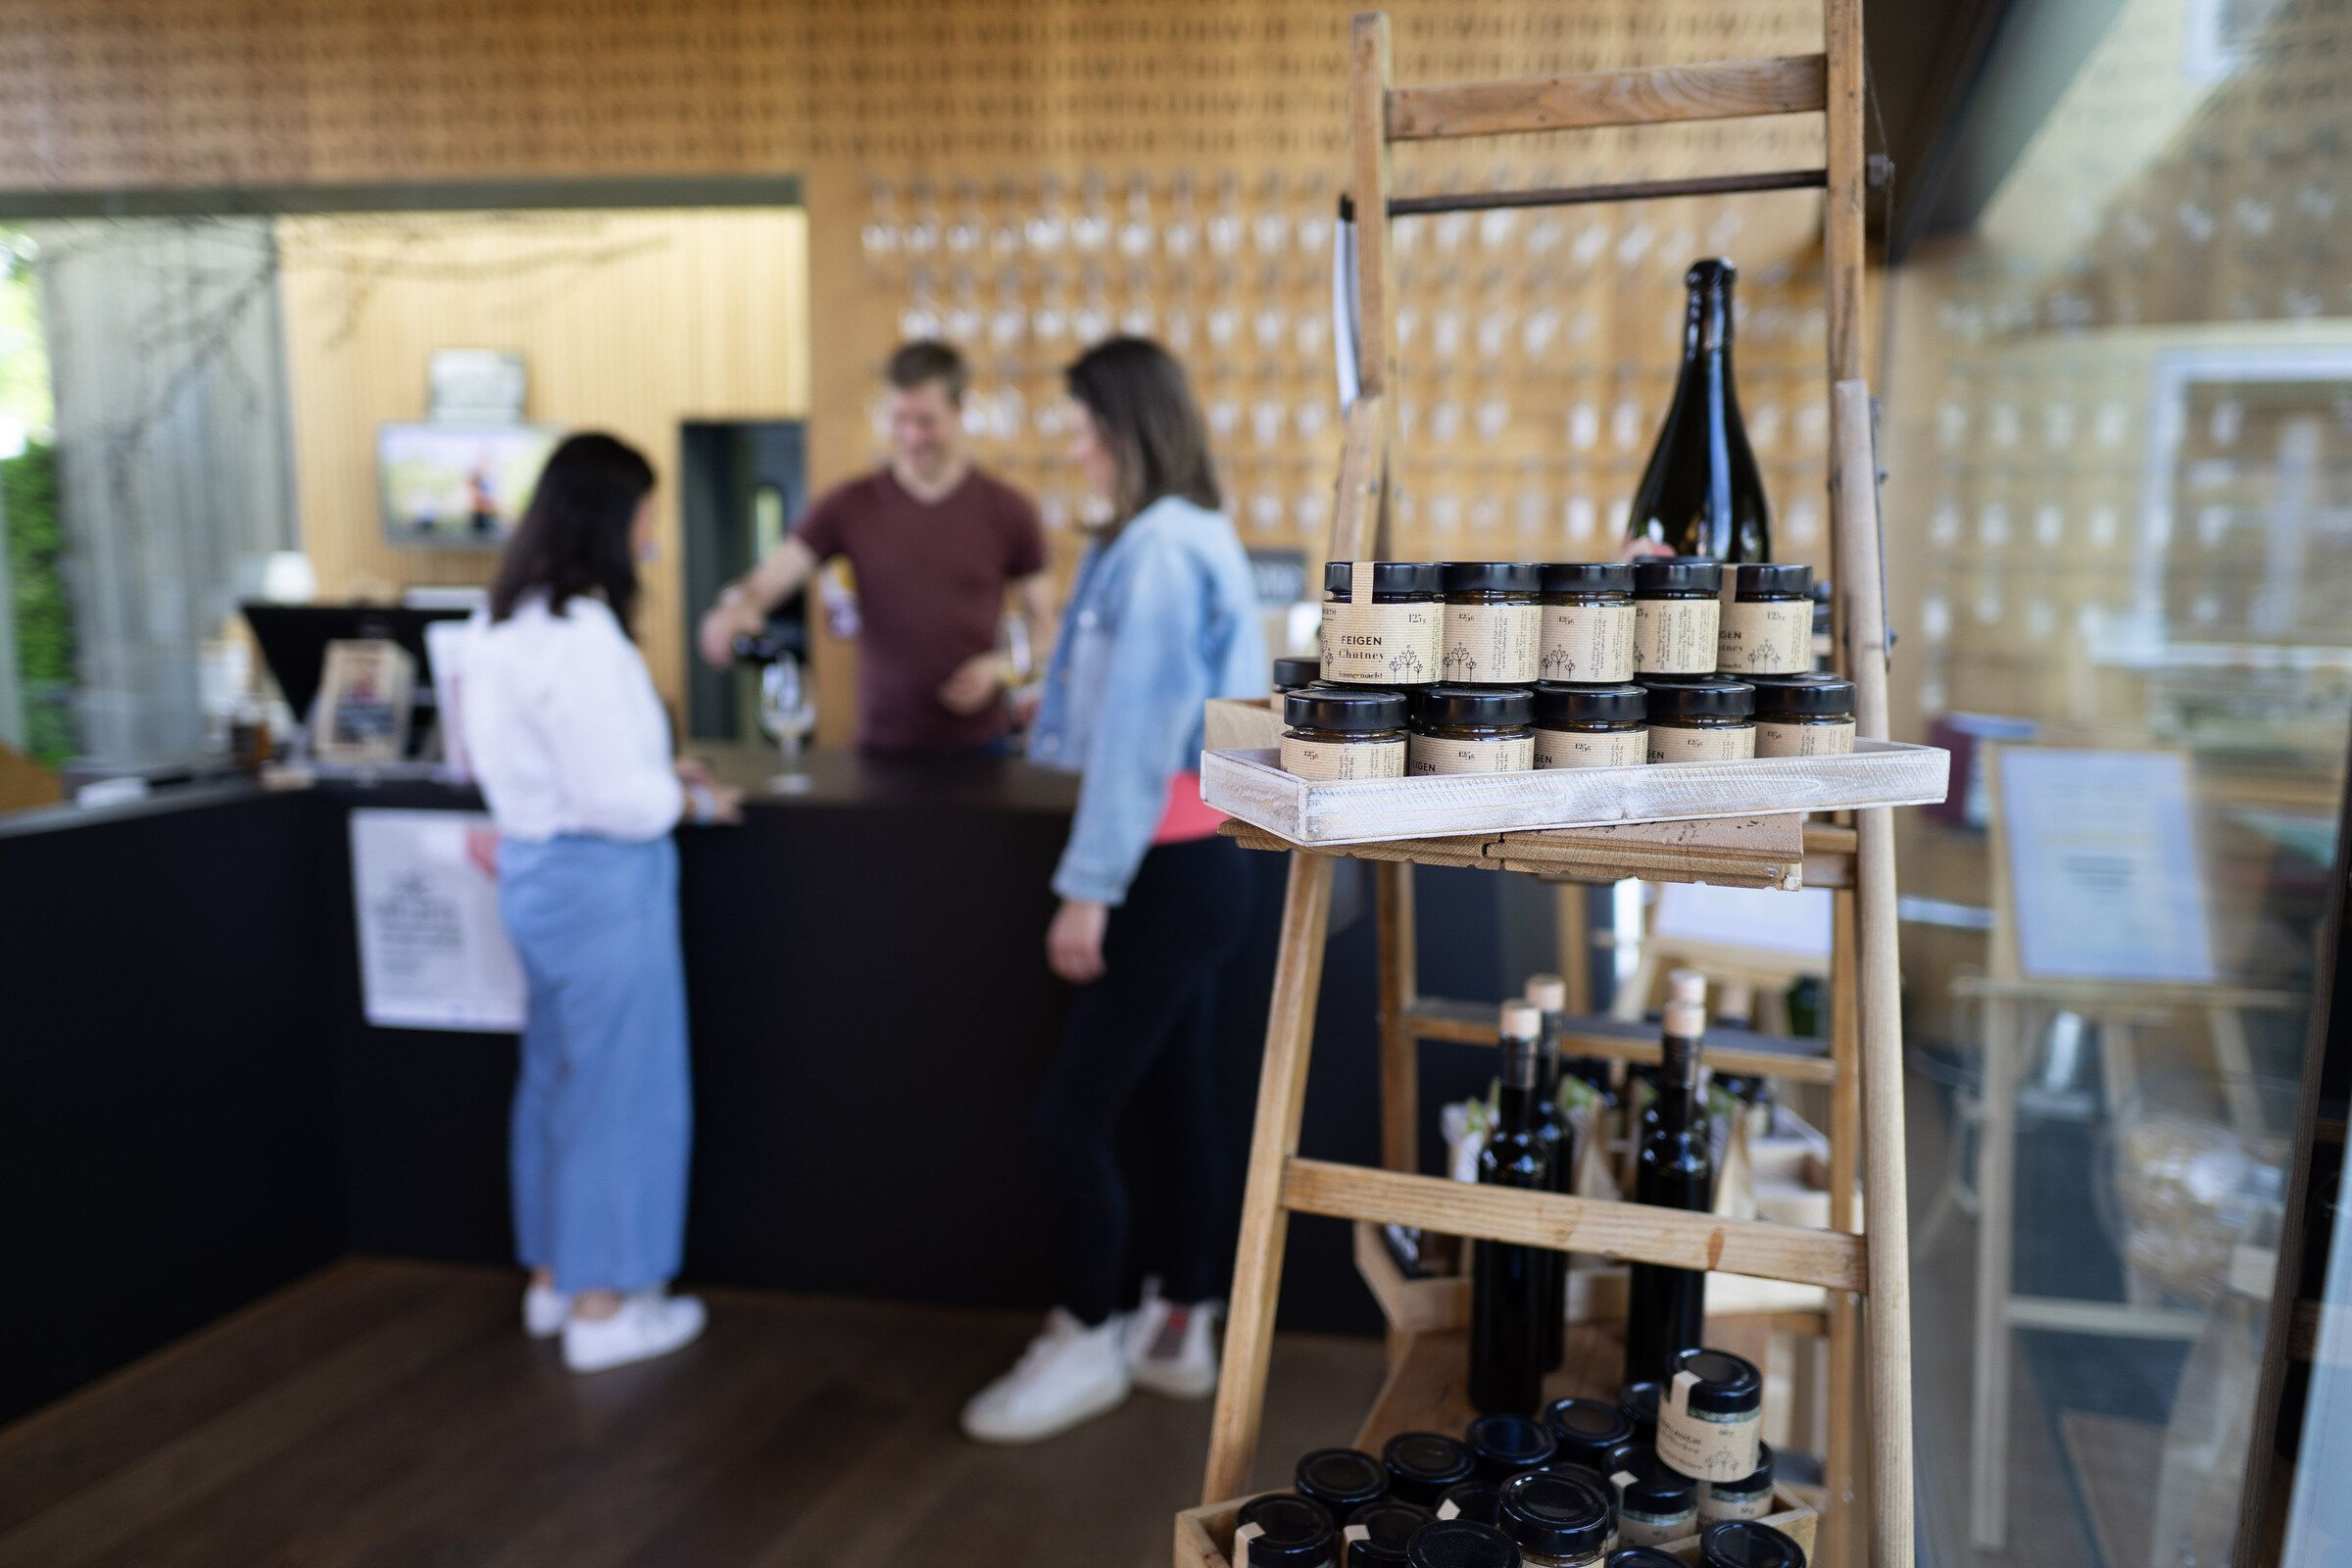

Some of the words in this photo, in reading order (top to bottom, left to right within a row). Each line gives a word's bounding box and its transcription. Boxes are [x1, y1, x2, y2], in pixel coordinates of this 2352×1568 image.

[1341, 635, 1383, 646] FEIGEN
[1339, 649, 1384, 663] Chutney
[1534, 754, 1552, 764] GEN
